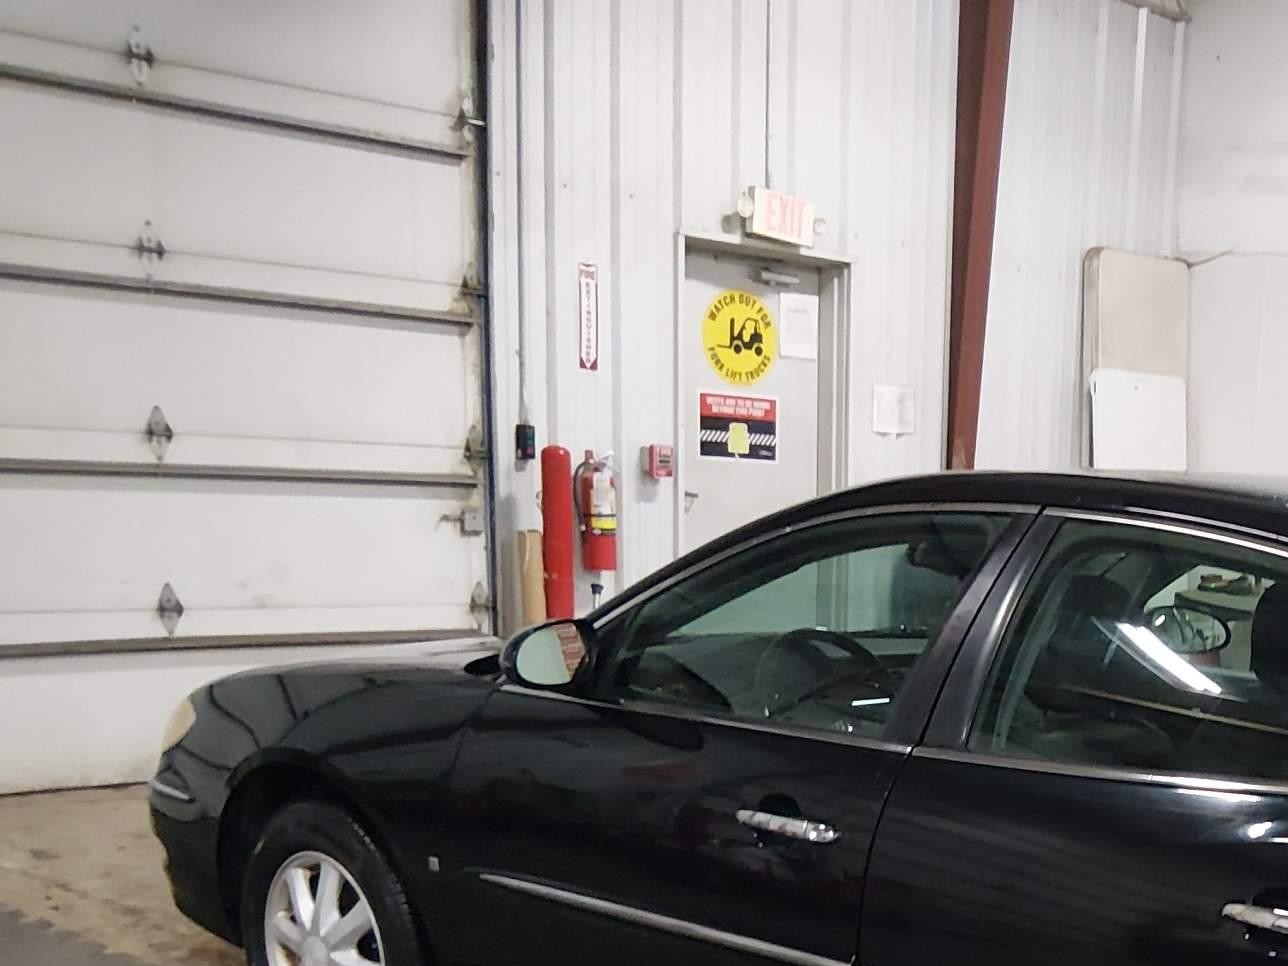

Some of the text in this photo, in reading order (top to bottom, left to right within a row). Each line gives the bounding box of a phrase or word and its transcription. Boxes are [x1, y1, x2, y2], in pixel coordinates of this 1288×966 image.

[767, 191, 806, 239] EXIT
[707, 293, 772, 330] WATCH OUT FOR
[725, 368, 743, 382] LIFT
[744, 354, 772, 382] TRUCKS
